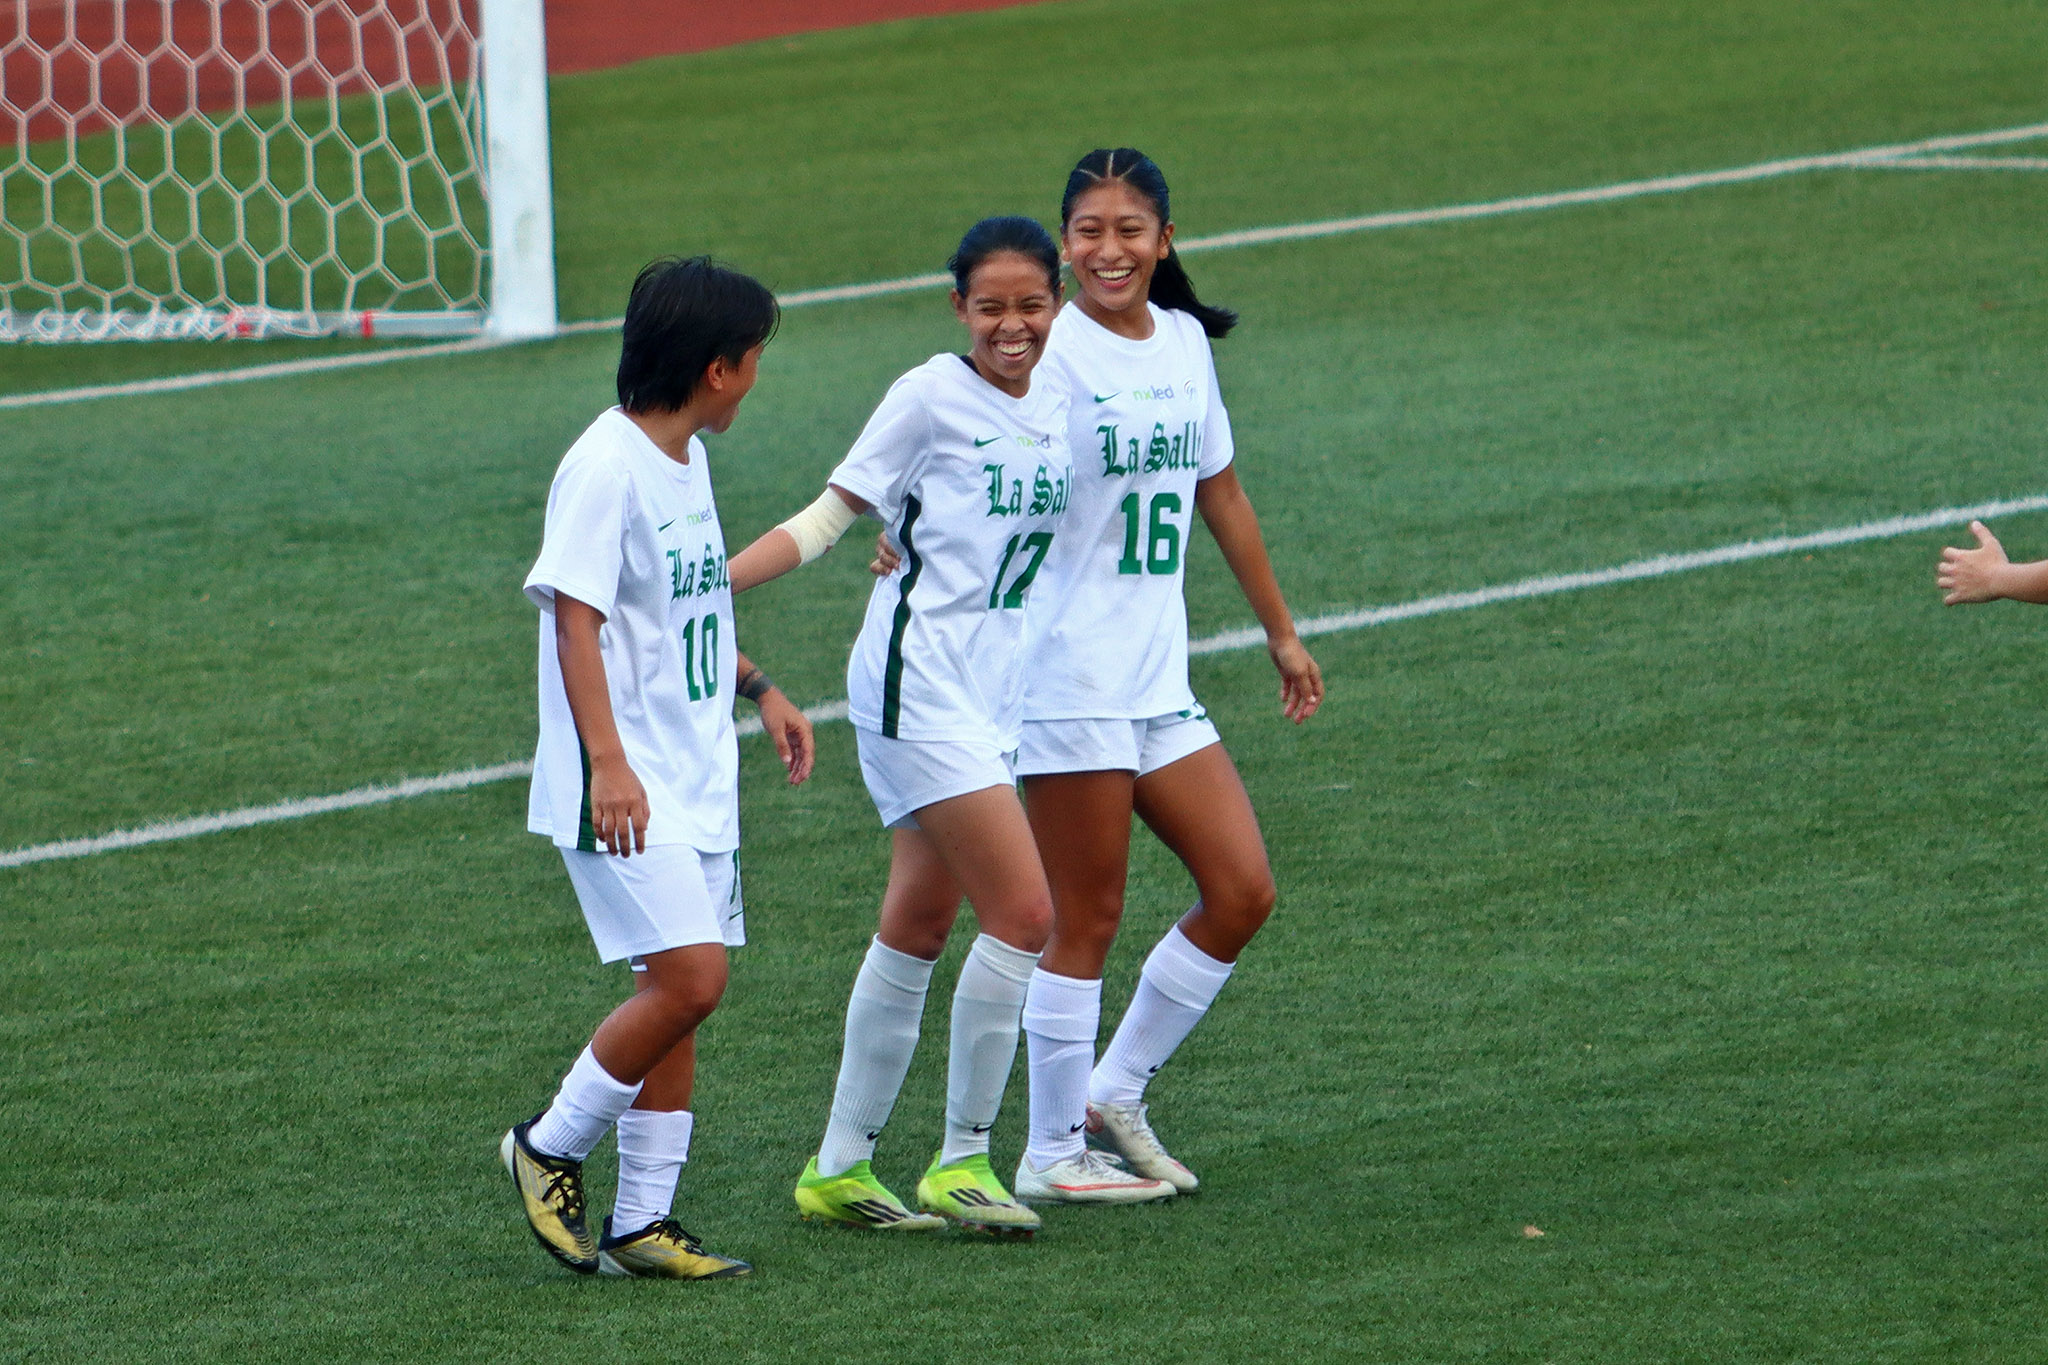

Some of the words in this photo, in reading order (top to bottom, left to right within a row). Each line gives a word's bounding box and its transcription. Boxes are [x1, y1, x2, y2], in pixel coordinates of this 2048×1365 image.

[1096, 423, 1139, 478] La
[1143, 419, 1201, 473] Sall
[983, 463, 1023, 518] La
[1028, 464, 1072, 516] Sal
[1118, 492, 1181, 575] 16
[666, 547, 695, 602] La
[988, 532, 1055, 609] 17
[682, 612, 718, 702] 10
